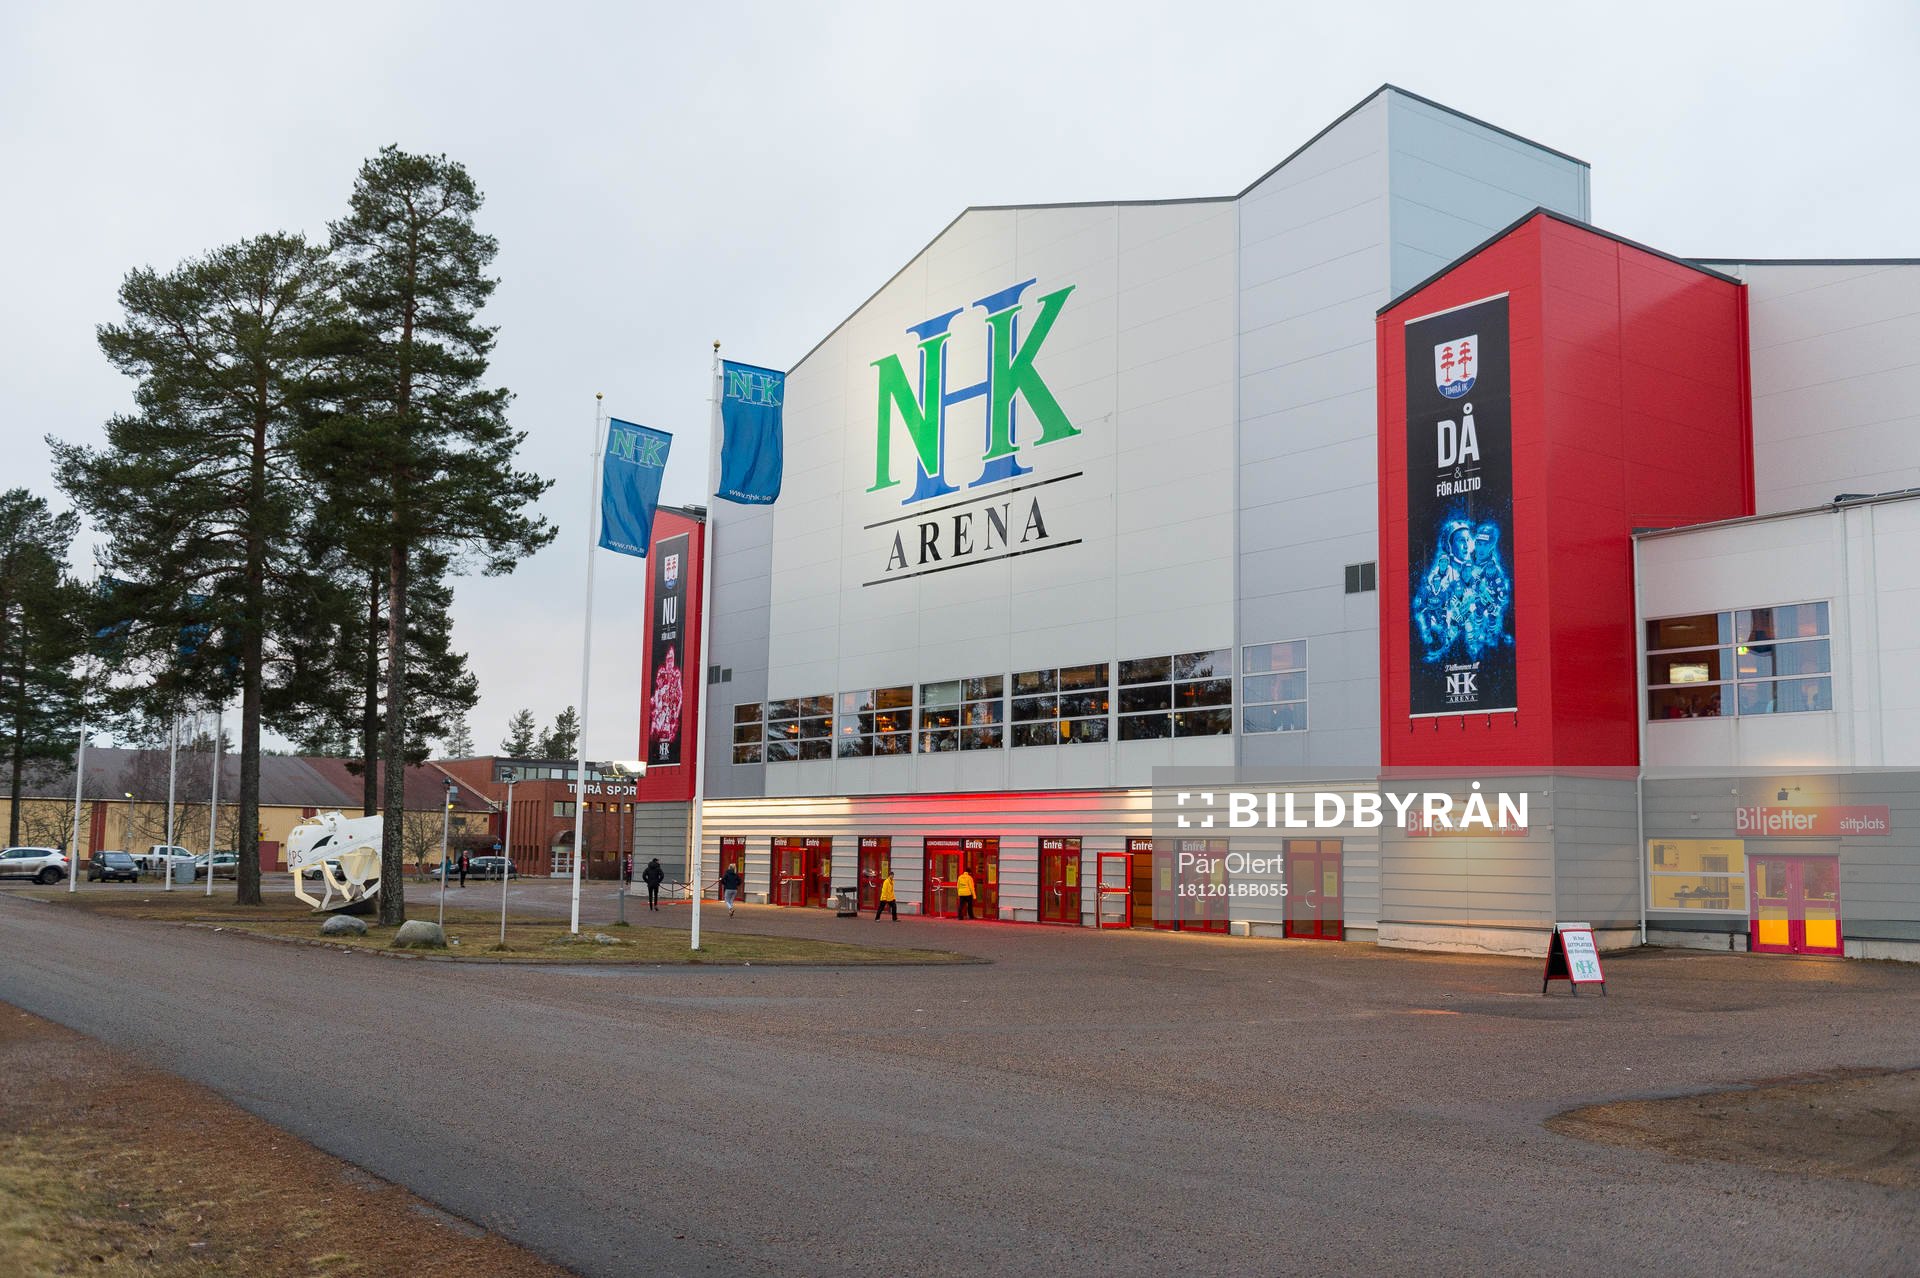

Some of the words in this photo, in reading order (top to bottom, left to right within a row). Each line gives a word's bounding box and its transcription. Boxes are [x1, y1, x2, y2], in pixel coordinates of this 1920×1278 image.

[1437, 402, 1480, 469] DÅ
[1436, 481, 1453, 497] FÖR
[1453, 476, 1481, 494] ALLTID
[885, 496, 1050, 572] ARENA
[662, 596, 677, 625] NU
[567, 782, 602, 795] TIRÅ
[1736, 807, 1817, 836] Biljetter
[1839, 815, 1885, 833] sittplats
[1043, 839, 1063, 849] Entré
[1131, 840, 1153, 850] Entré
